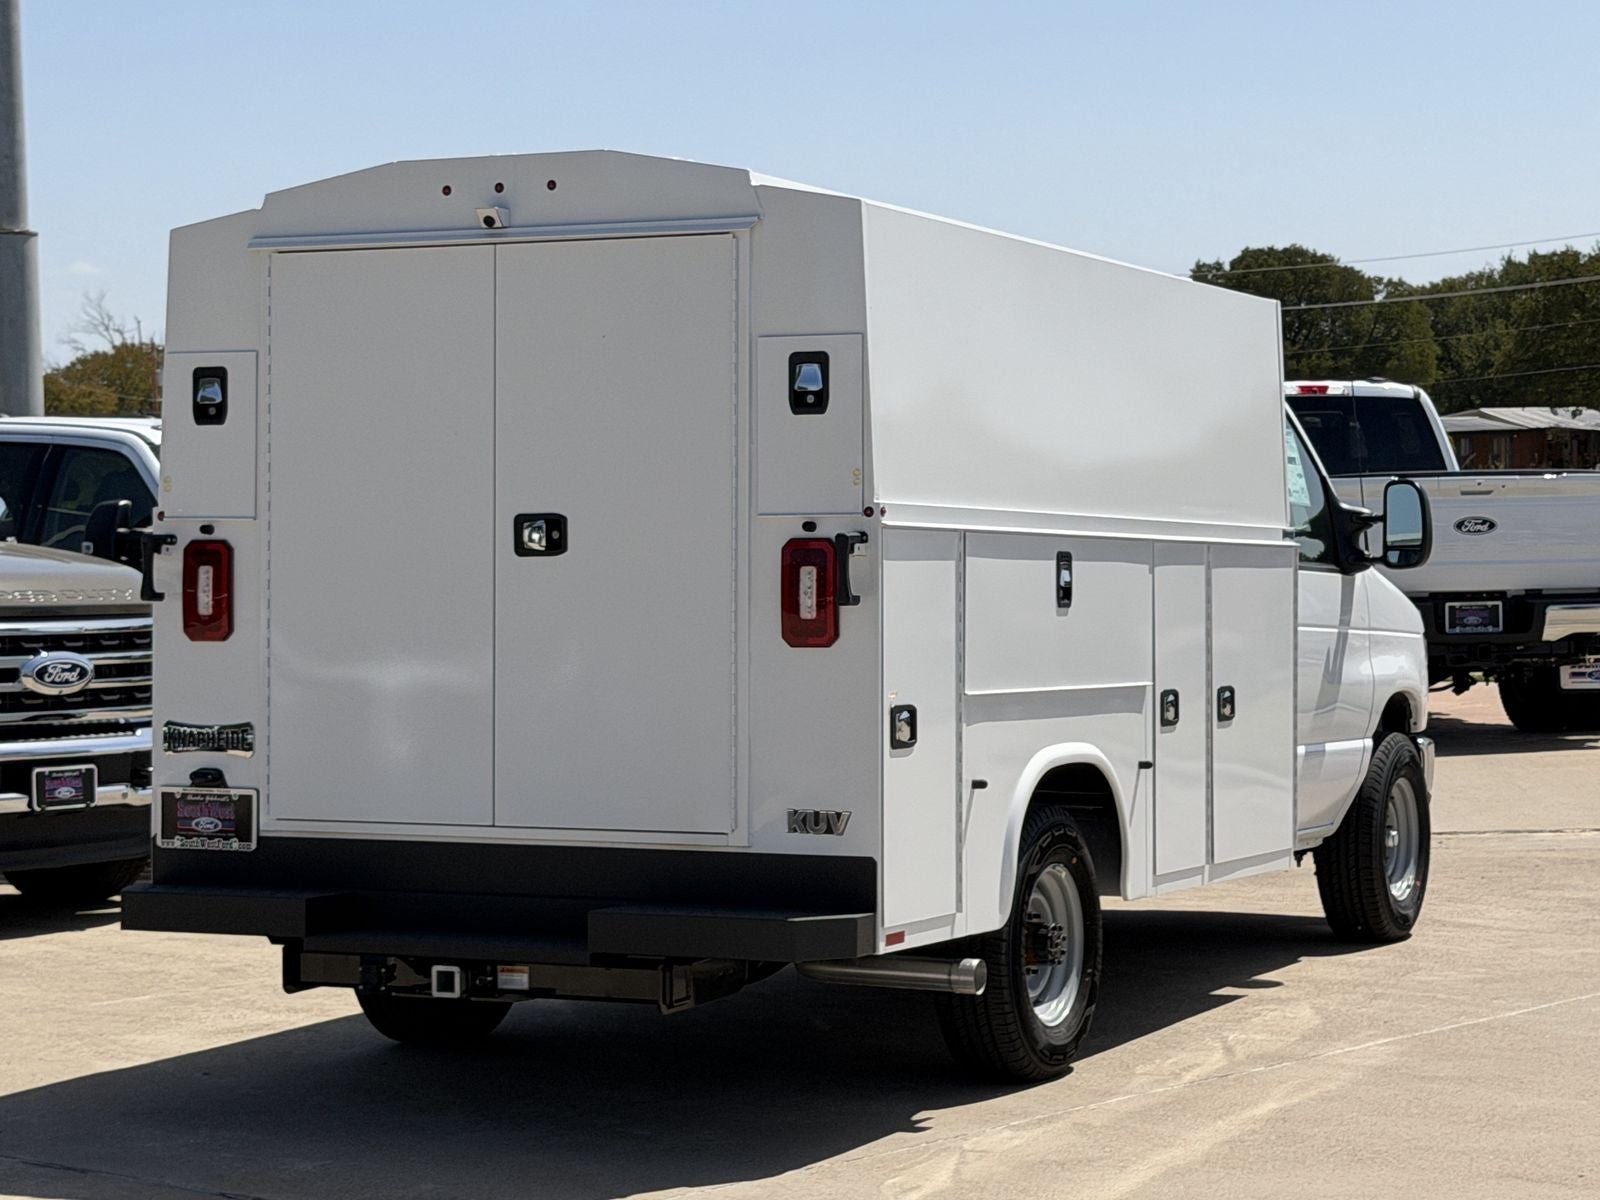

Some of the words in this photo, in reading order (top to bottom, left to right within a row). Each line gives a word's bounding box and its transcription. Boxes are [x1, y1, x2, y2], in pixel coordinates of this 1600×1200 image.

[1461, 519, 1490, 531] Ford
[44, 663, 81, 682] Ford
[787, 808, 852, 836] KUV
